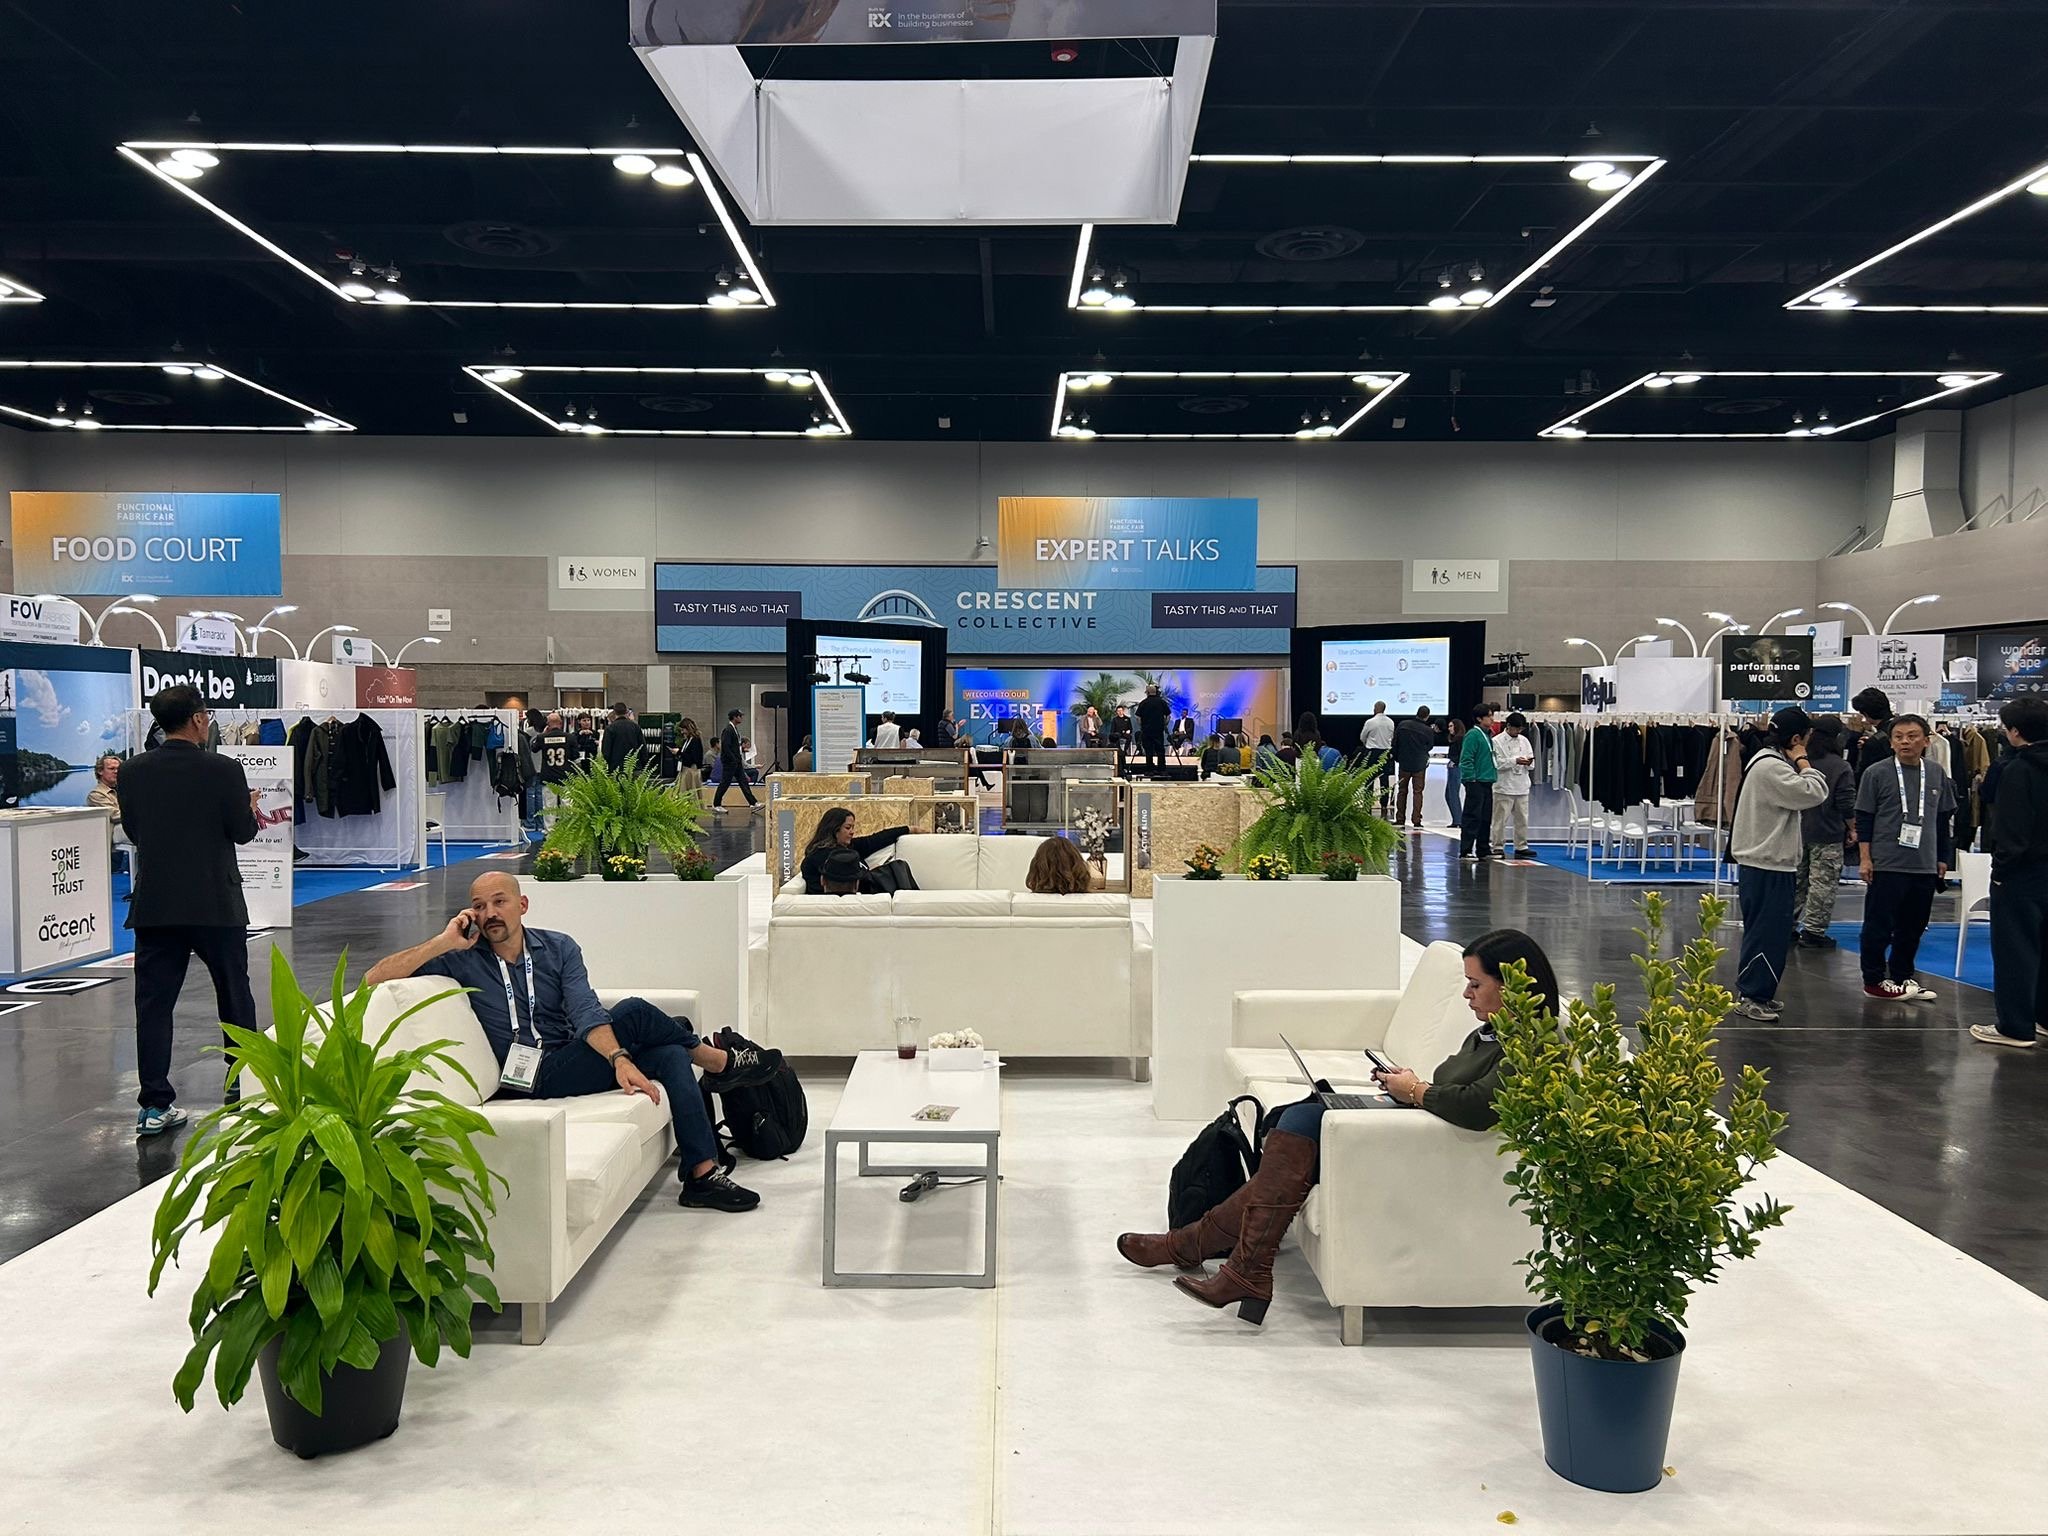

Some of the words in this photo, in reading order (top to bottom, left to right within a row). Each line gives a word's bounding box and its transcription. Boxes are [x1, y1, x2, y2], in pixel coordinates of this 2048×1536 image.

[868, 13, 892, 28] RX
[117, 504, 174, 512] FUNCTIONAL
[117, 513, 150, 521] FABRIC
[153, 513, 174, 521] FAIR
[52, 537, 136, 562] FOOD
[144, 537, 242, 562] COURT
[1036, 540, 1134, 561] EXPERT
[1141, 539, 1220, 561] TALKS
[592, 568, 637, 577] WOMEN
[1457, 571, 1481, 579] MEN
[956, 592, 1097, 610] CRESCENT
[10, 600, 42, 620] FOV
[674, 603, 708, 612] TASTY
[712, 603, 736, 613] THIS
[761, 604, 789, 614] THAT
[1164, 606, 1198, 615] TASTY
[1201, 605, 1226, 615] THIS
[1250, 605, 1278, 615] THAT
[958, 617, 1096, 629] COLLECTIVE
[199, 628, 226, 640] Tamarack
[2001, 644, 2047, 656] wonder
[1730, 663, 1800, 671] performance
[253, 673, 276, 682] Tamarack
[208, 670, 235, 699] be
[970, 704, 1043, 719] EXPERT
[547, 748, 565, 766] 33
[52, 846, 80, 861] SOME
[784, 850, 790, 860] TO
[52, 880, 83, 896] TRUST
[39, 913, 95, 941] accent
